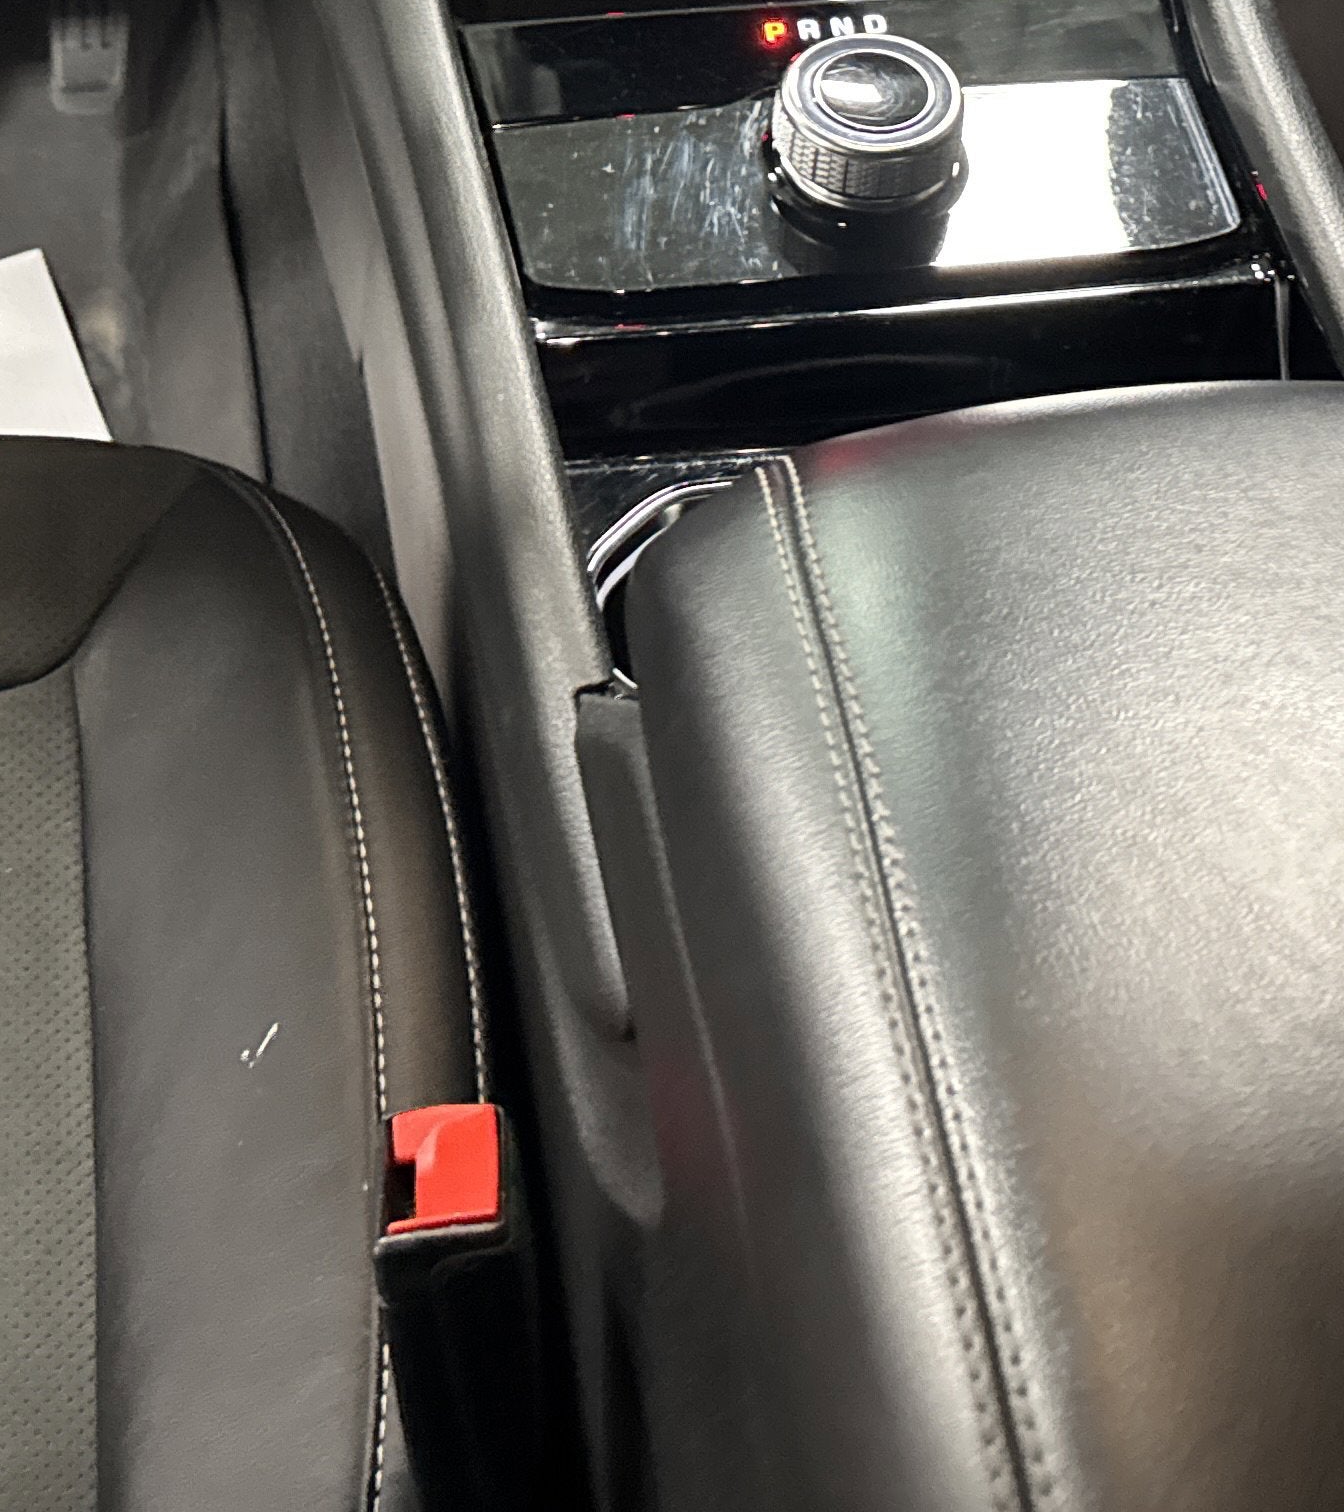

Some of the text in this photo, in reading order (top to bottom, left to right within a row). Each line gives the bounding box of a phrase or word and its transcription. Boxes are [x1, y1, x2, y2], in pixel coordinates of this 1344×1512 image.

[763, 13, 888, 43] P R N D
